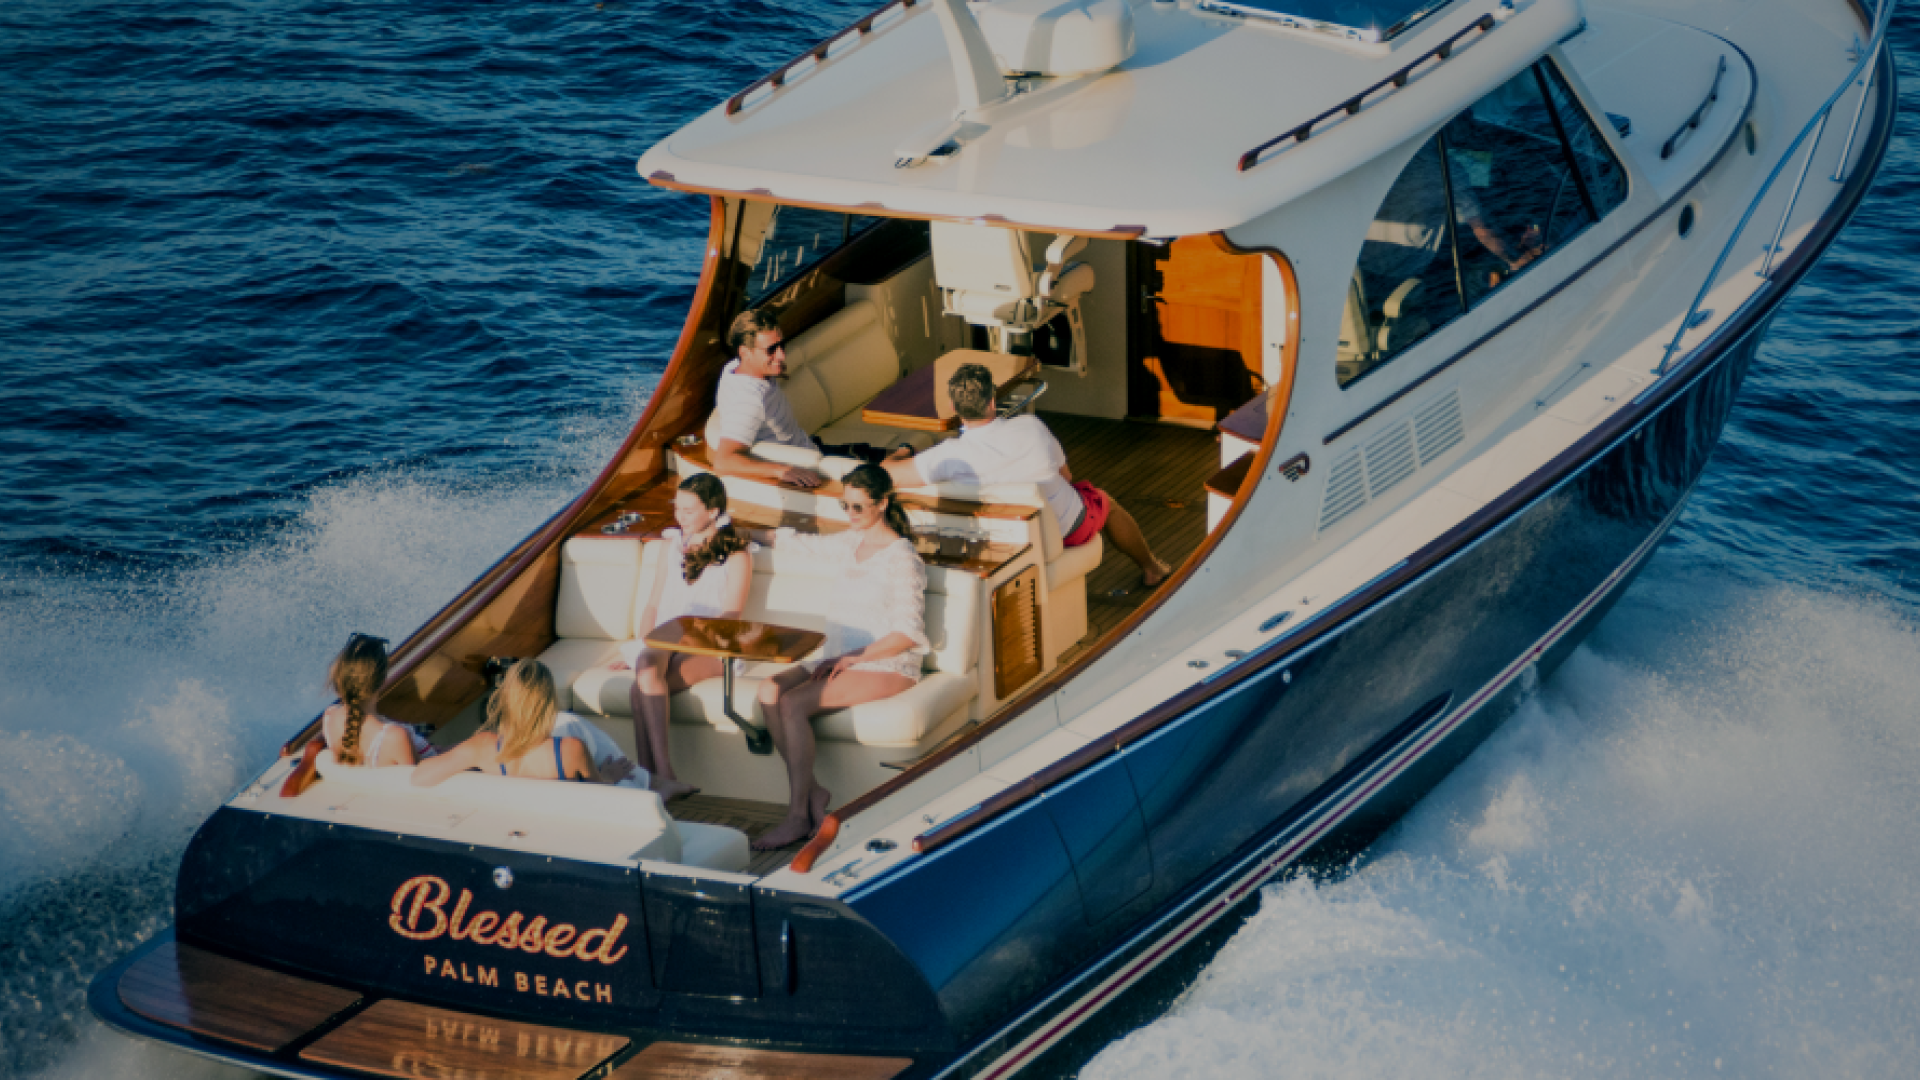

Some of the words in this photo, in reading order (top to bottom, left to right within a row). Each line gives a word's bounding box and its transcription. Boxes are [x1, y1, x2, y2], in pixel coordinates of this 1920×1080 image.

[389, 875, 628, 964] Blessed
[424, 954, 498, 987] PALM
[515, 971, 613, 1003] BEACH
